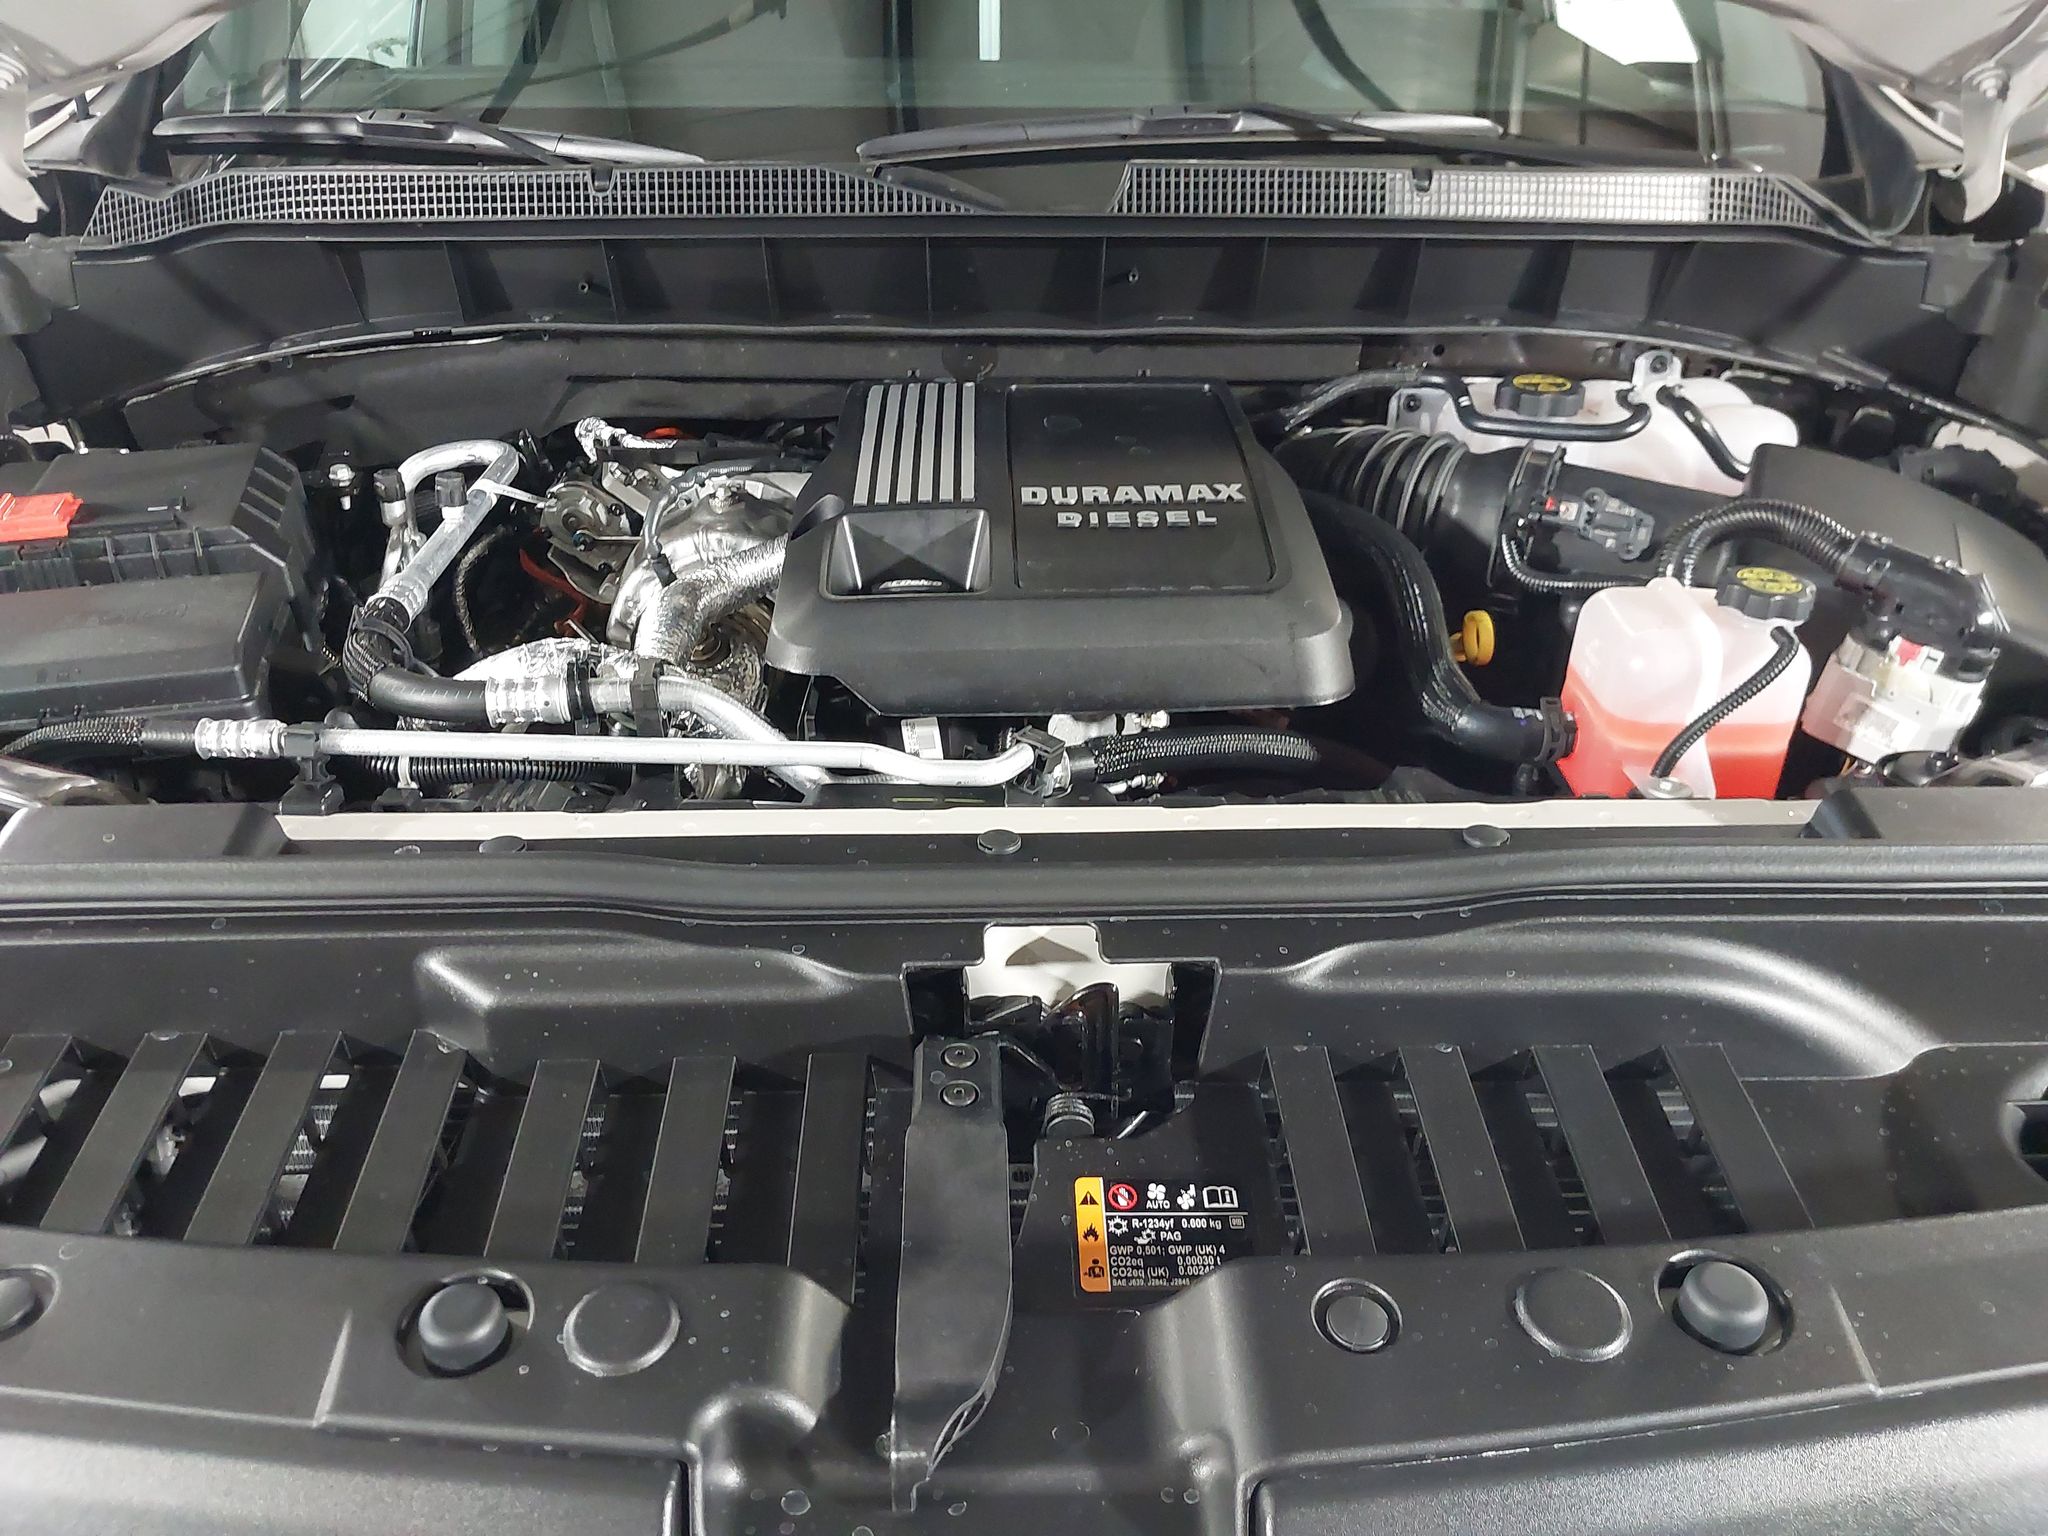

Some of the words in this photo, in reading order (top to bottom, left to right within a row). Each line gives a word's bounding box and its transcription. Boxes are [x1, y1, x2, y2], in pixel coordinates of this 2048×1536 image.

[1021, 483, 1247, 505] DURAMAX
[1057, 510, 1218, 528] DIESEL
[1146, 1200, 1171, 1209] AUTO
[1132, 1217, 1174, 1230] R-1234yf
[1209, 1218, 1222, 1230] kg
[1160, 1231, 1182, 1241] PAG
[1110, 1245, 1134, 1255] GWP
[1168, 1244, 1192, 1255] GWP
[1195, 1244, 1217, 1256] (UK)
[1219, 1244, 1226, 1255] 4
[1110, 1256, 1144, 1268] CO2eq
[1111, 1267, 1145, 1279] CO2eq
[1147, 1266, 1169, 1280] (UK)
